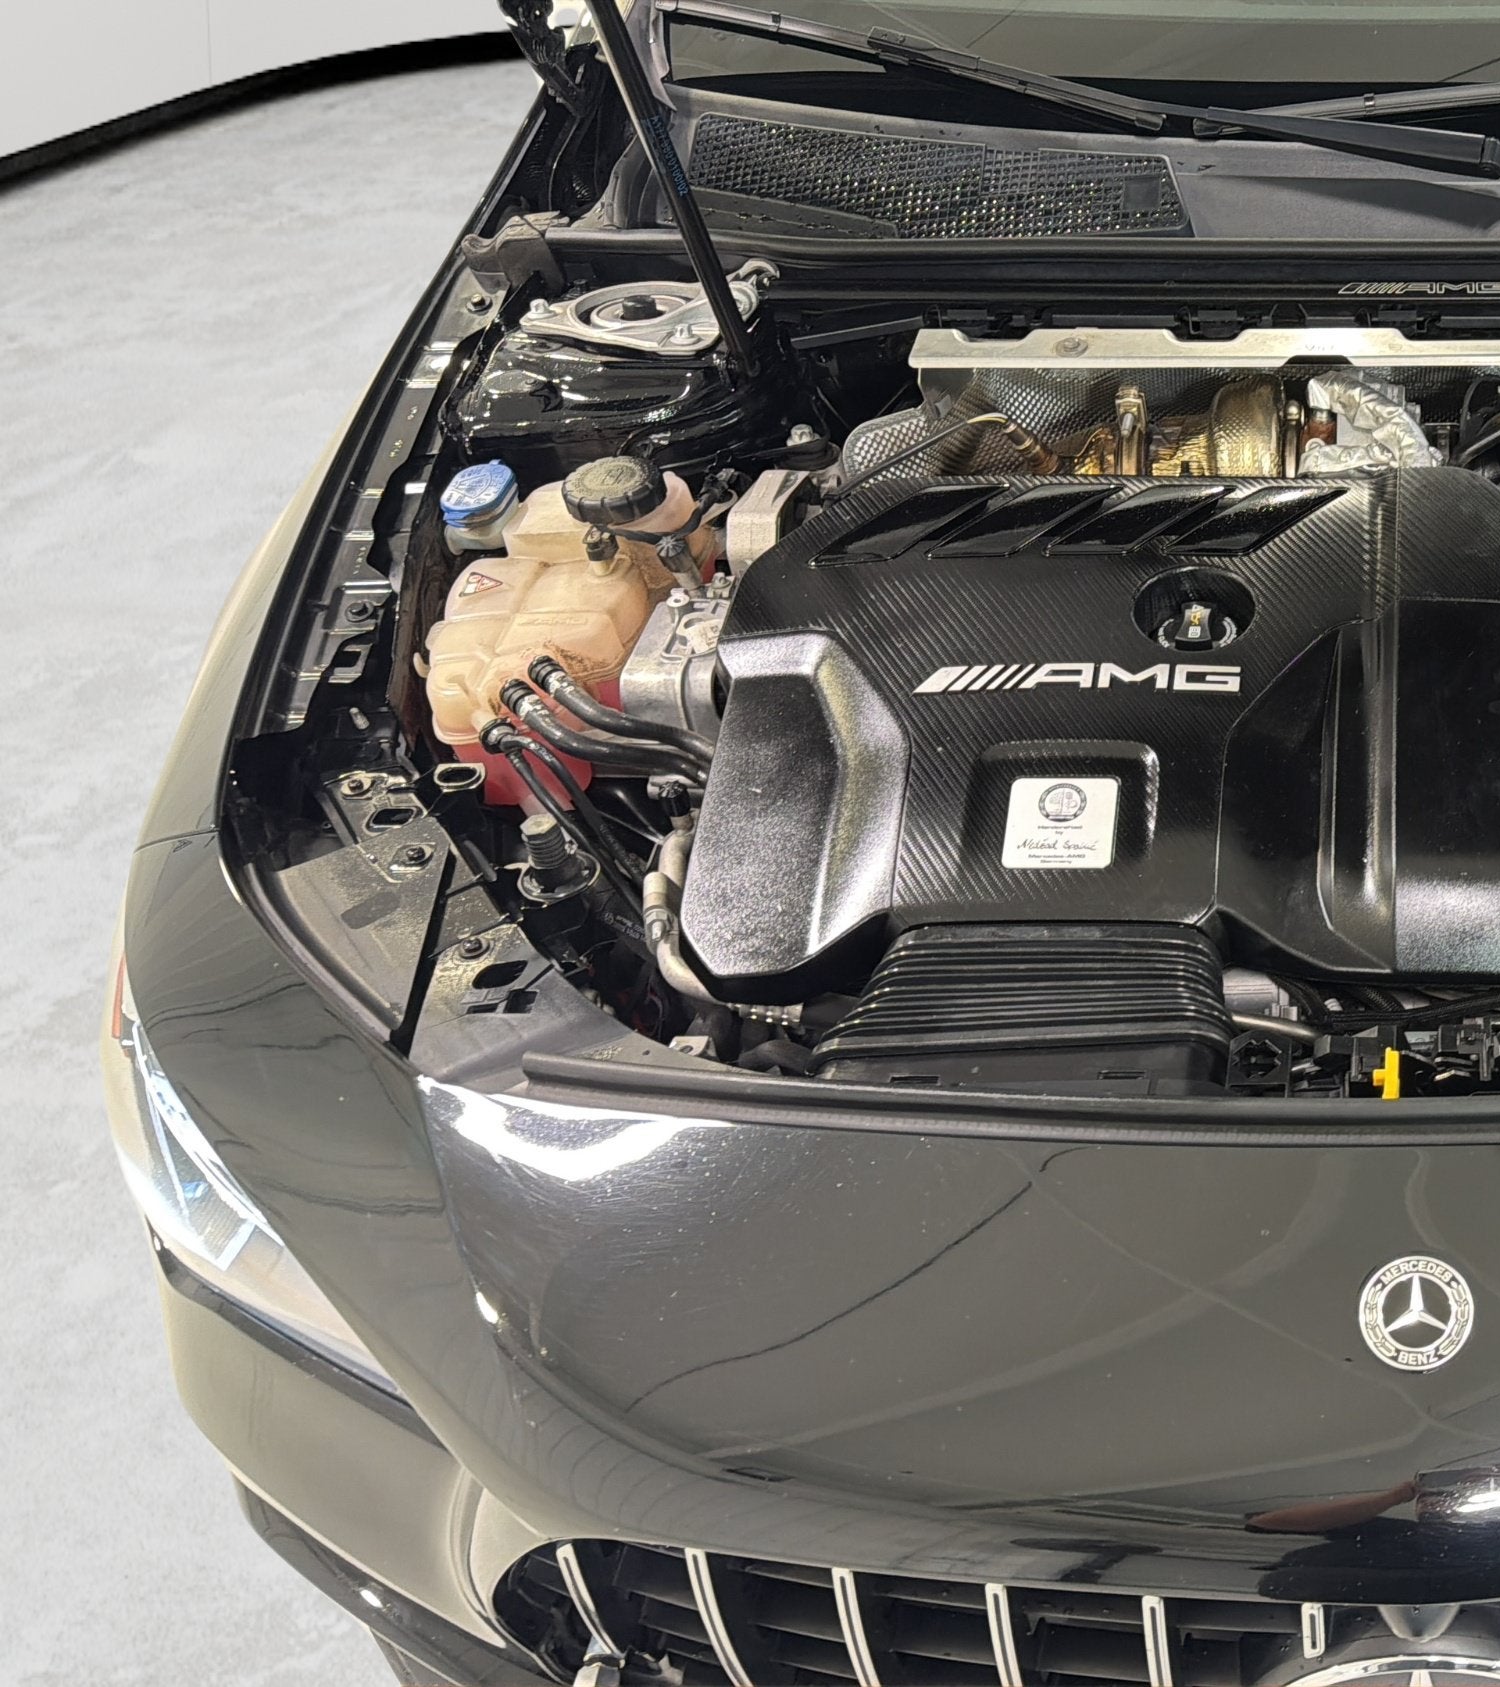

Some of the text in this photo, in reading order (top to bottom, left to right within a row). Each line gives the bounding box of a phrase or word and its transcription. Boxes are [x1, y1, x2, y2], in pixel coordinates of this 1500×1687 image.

[1018, 662, 1242, 693] AMG
[1380, 1260, 1453, 1284] MERCEDES
[1397, 1349, 1439, 1366] BENZ
